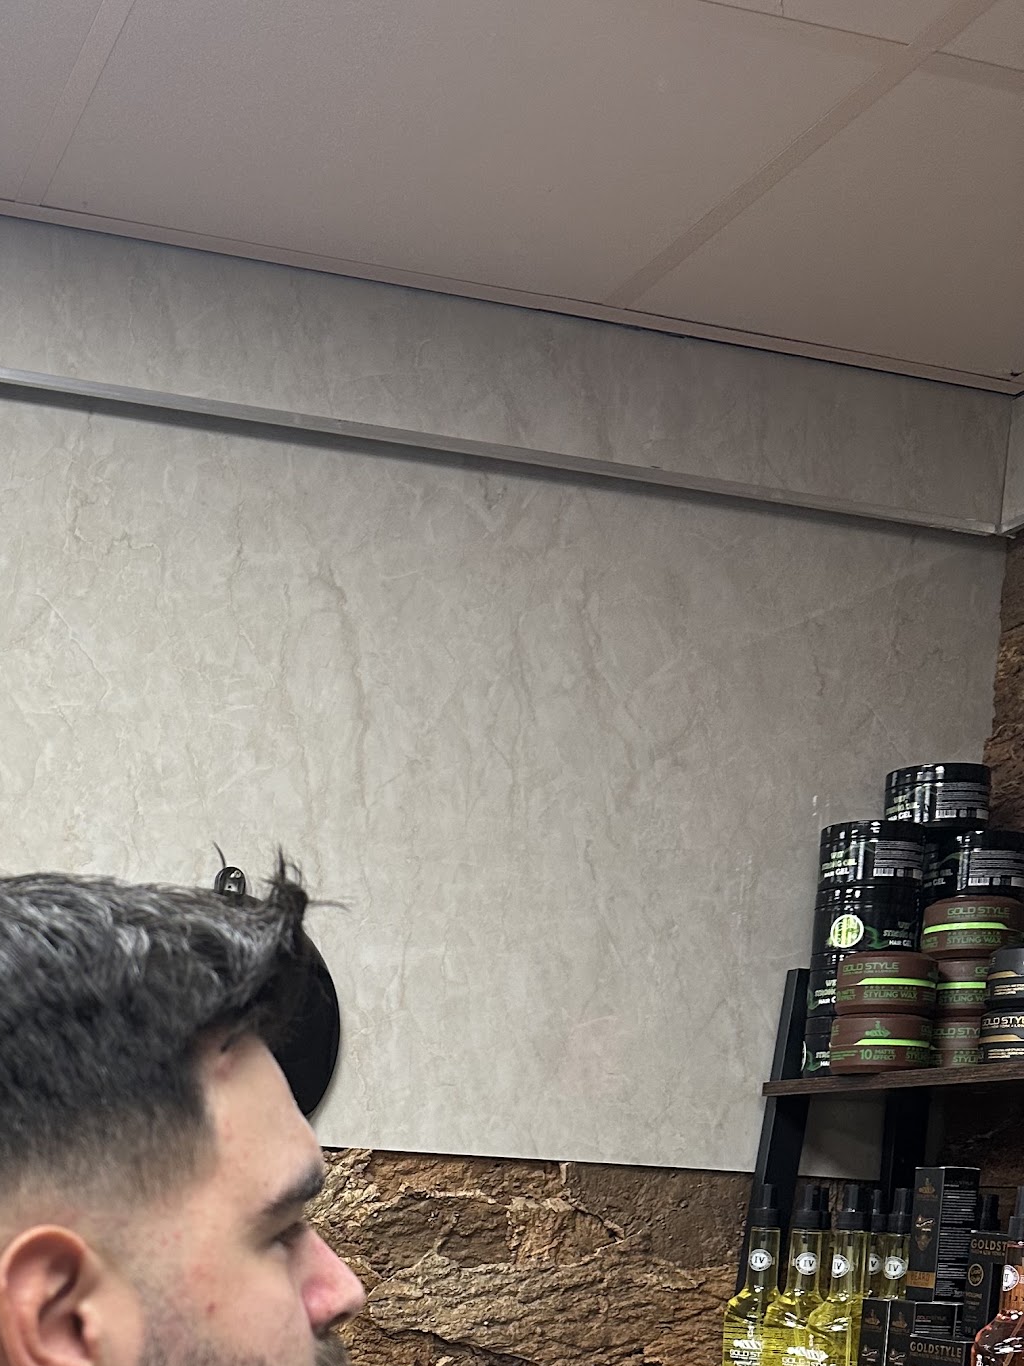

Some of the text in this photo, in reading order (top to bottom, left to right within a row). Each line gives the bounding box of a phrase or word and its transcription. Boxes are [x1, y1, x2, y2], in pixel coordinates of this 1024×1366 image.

[898, 811, 913, 820] GEL
[836, 867, 849, 875] GEL
[947, 907, 1010, 916] GOLD STYLE
[947, 936, 1002, 944] STYLING WAX
[842, 962, 900, 972] GOLD STYLE
[1001, 1016, 1024, 1024] STY
[860, 1049, 873, 1060] 10
[970, 1239, 1007, 1251] GOLDST
[909, 1341, 962, 1358] GOLDSTYLE
